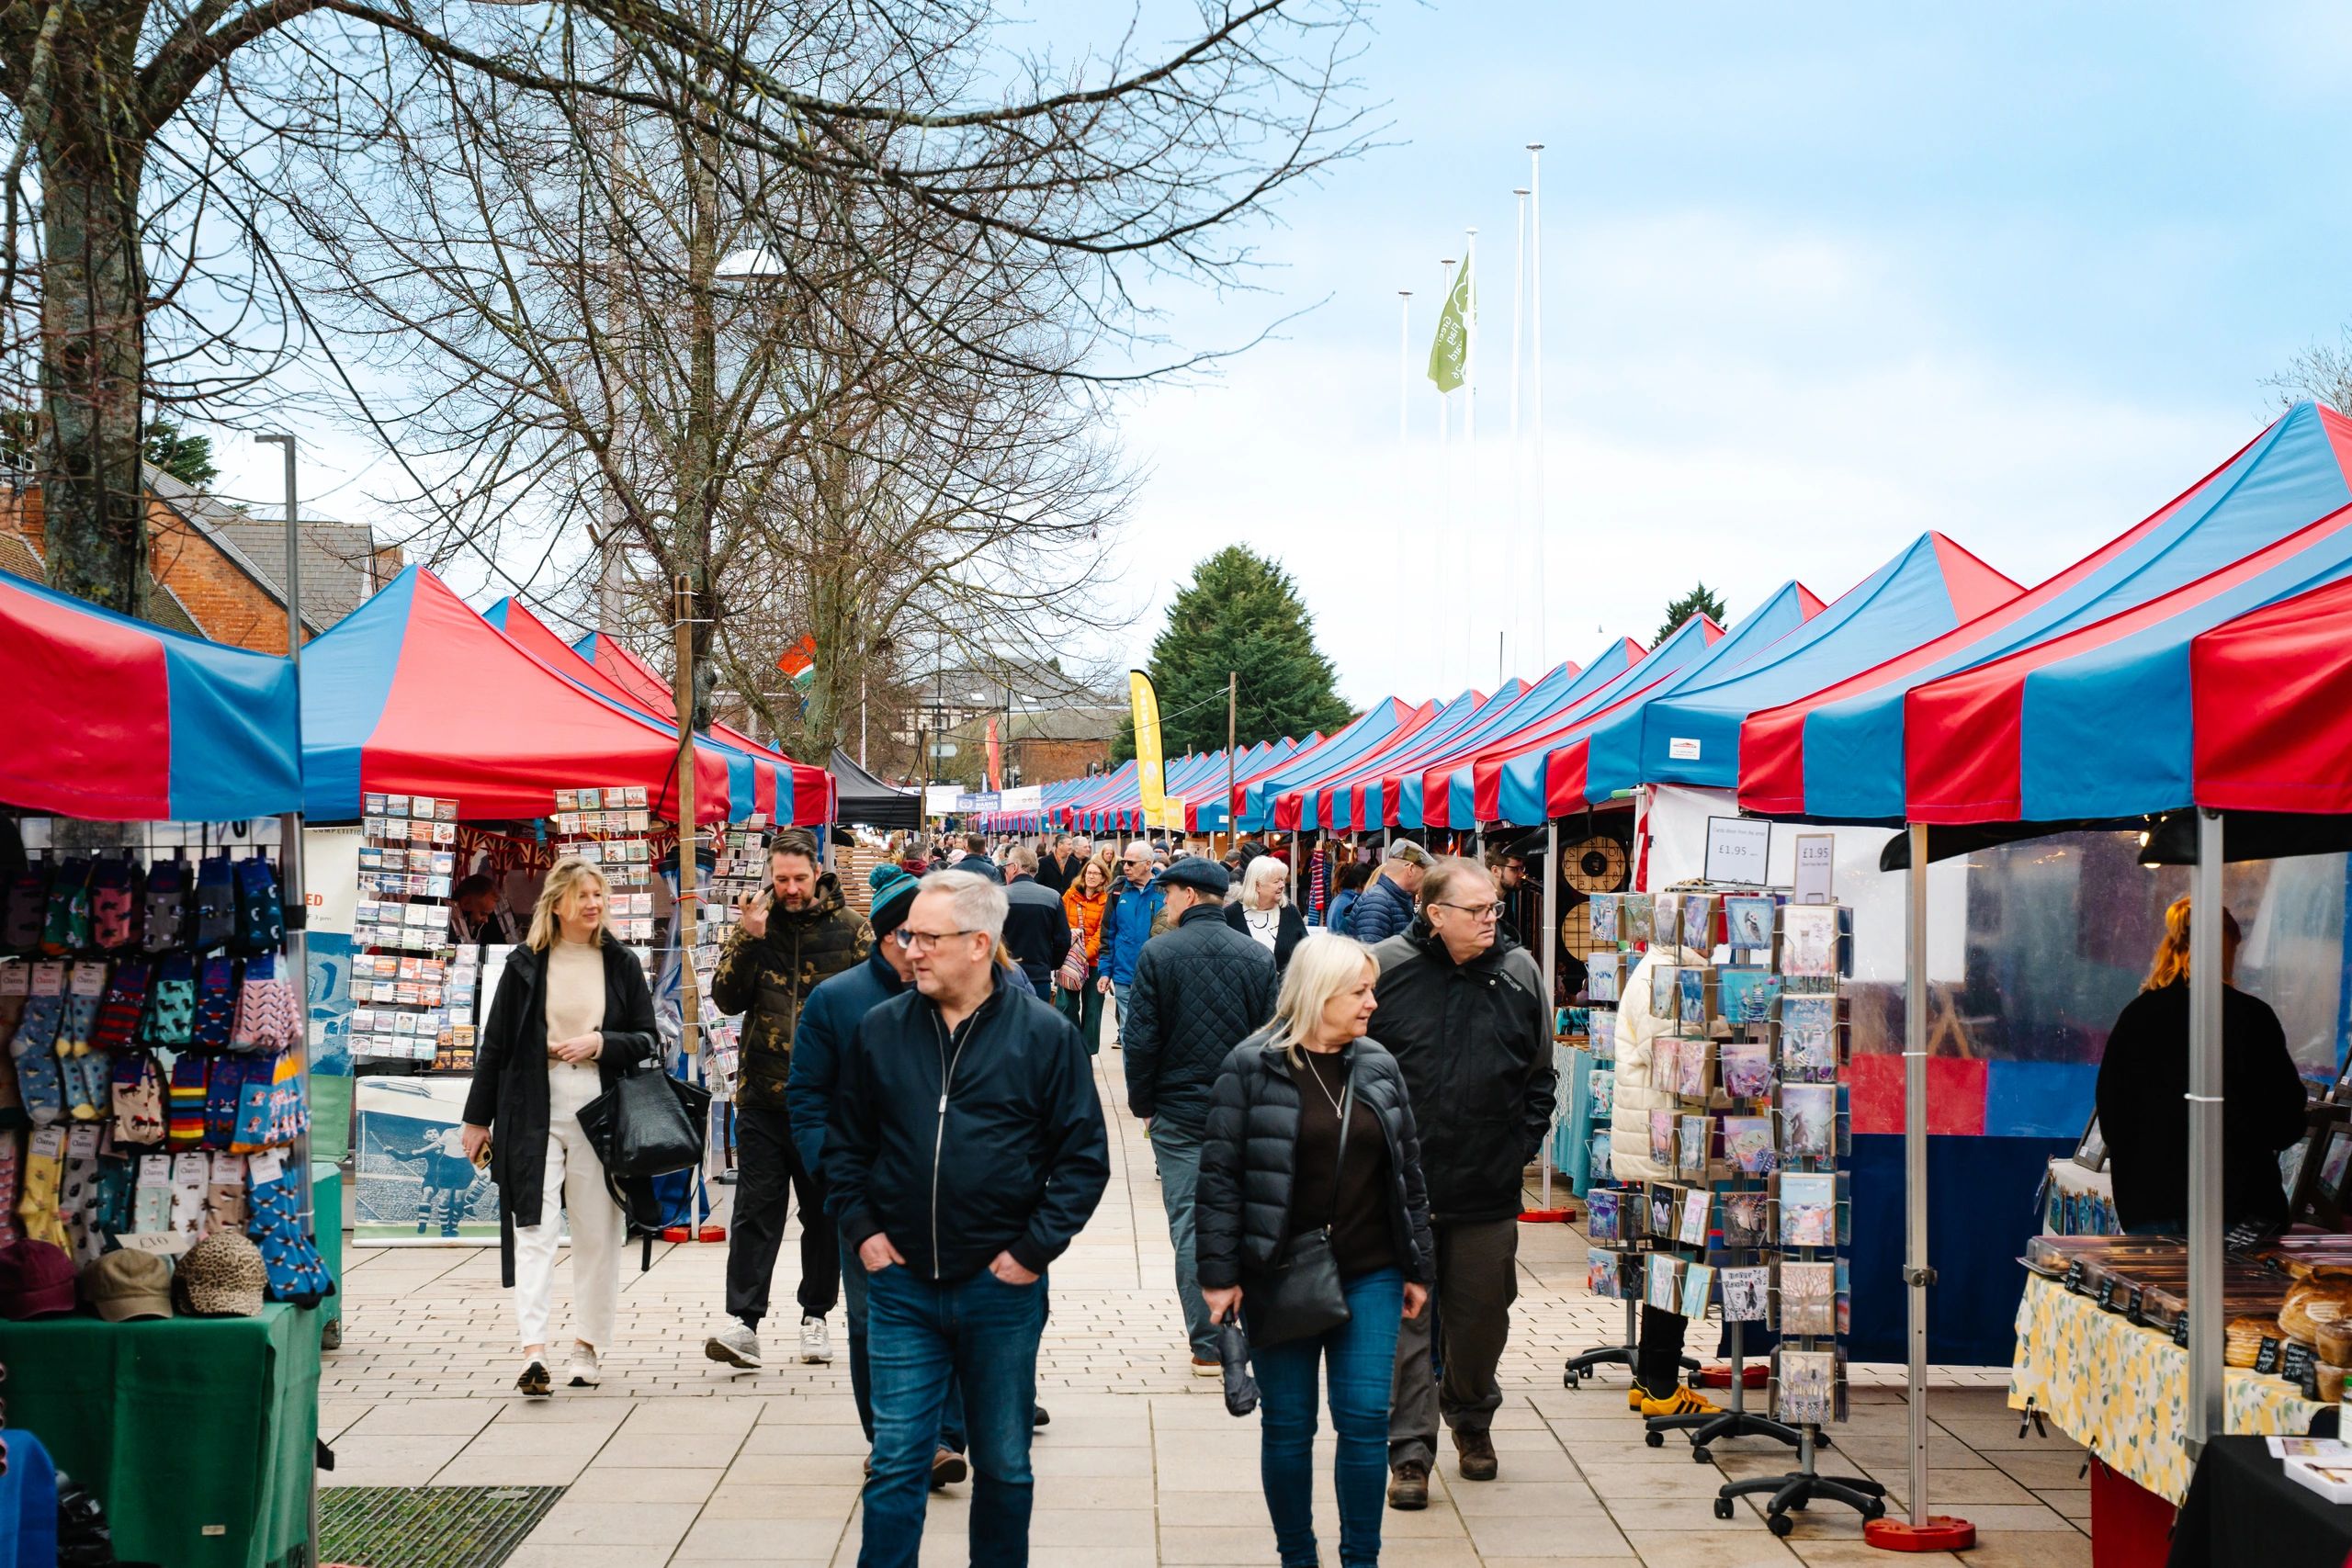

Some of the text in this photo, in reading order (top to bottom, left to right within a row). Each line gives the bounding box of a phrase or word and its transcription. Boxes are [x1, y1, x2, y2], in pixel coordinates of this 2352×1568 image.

[1719, 845, 1747, 855] £1.95
[1803, 848, 1828, 858] £1.95
[140, 1236, 169, 1249] £10
